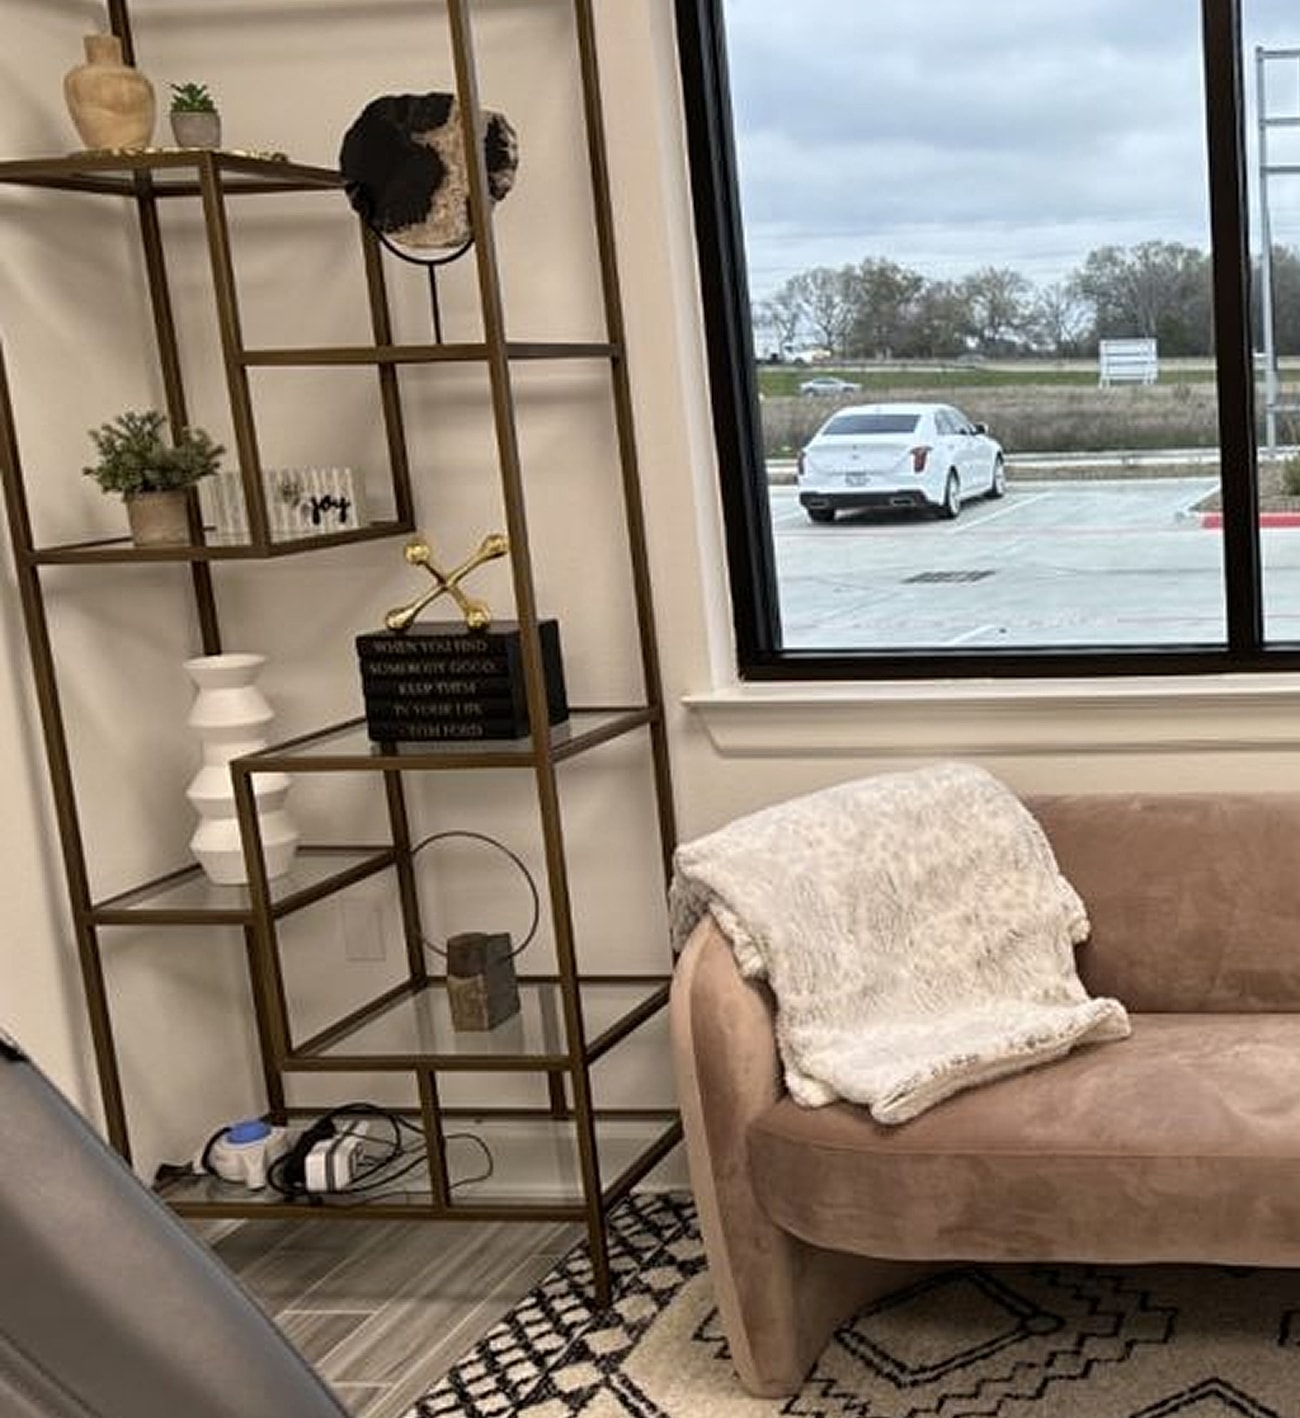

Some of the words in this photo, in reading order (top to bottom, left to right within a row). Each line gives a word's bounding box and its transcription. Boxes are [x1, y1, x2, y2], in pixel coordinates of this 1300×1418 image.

[309, 494, 351, 526] joy
[373, 639, 417, 654] WHEN
[418, 639, 452, 654] YOU
[454, 639, 488, 653] FIND
[369, 660, 446, 675] SOMEBODY
[398, 681, 433, 695] KEEP
[436, 681, 477, 695] THEM
[412, 702, 452, 716] YOUR
